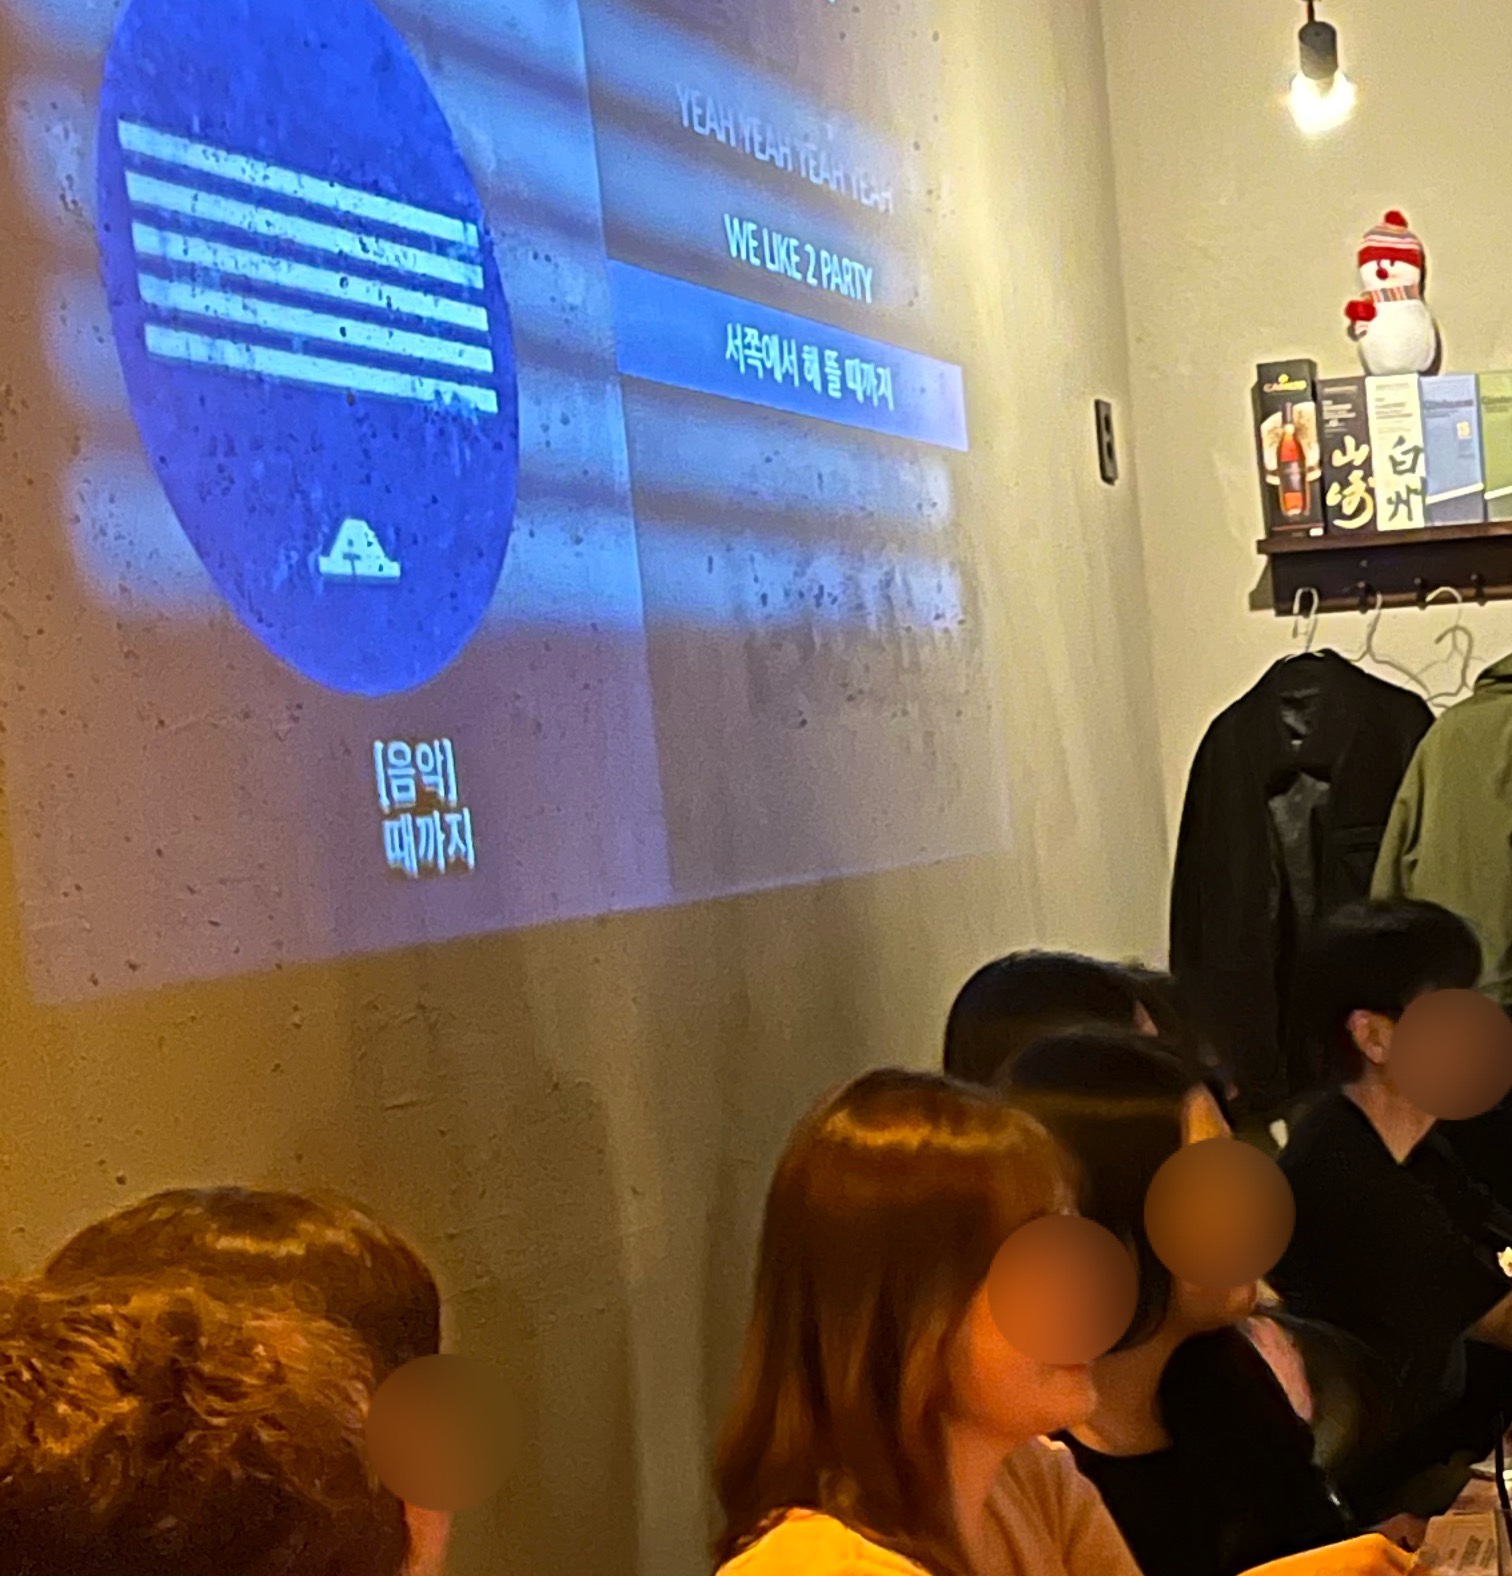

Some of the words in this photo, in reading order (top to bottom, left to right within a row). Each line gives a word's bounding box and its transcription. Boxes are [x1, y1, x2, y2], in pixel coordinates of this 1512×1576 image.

[676, 84, 736, 148] YEAH
[738, 111, 793, 173] YEAH
[796, 138, 846, 195] YEAH
[723, 213, 761, 267] WE
[762, 228, 802, 281] LIKE
[804, 243, 818, 287] 2
[819, 249, 873, 304] PARTY
[725, 322, 800, 388] 서쪽에서
[824, 349, 843, 399] 뜰
[844, 358, 894, 411] 때까지
[1386, 435, 1427, 522] 白州
[374, 738, 458, 814] [음악]
[382, 808, 475, 878] 때까지
